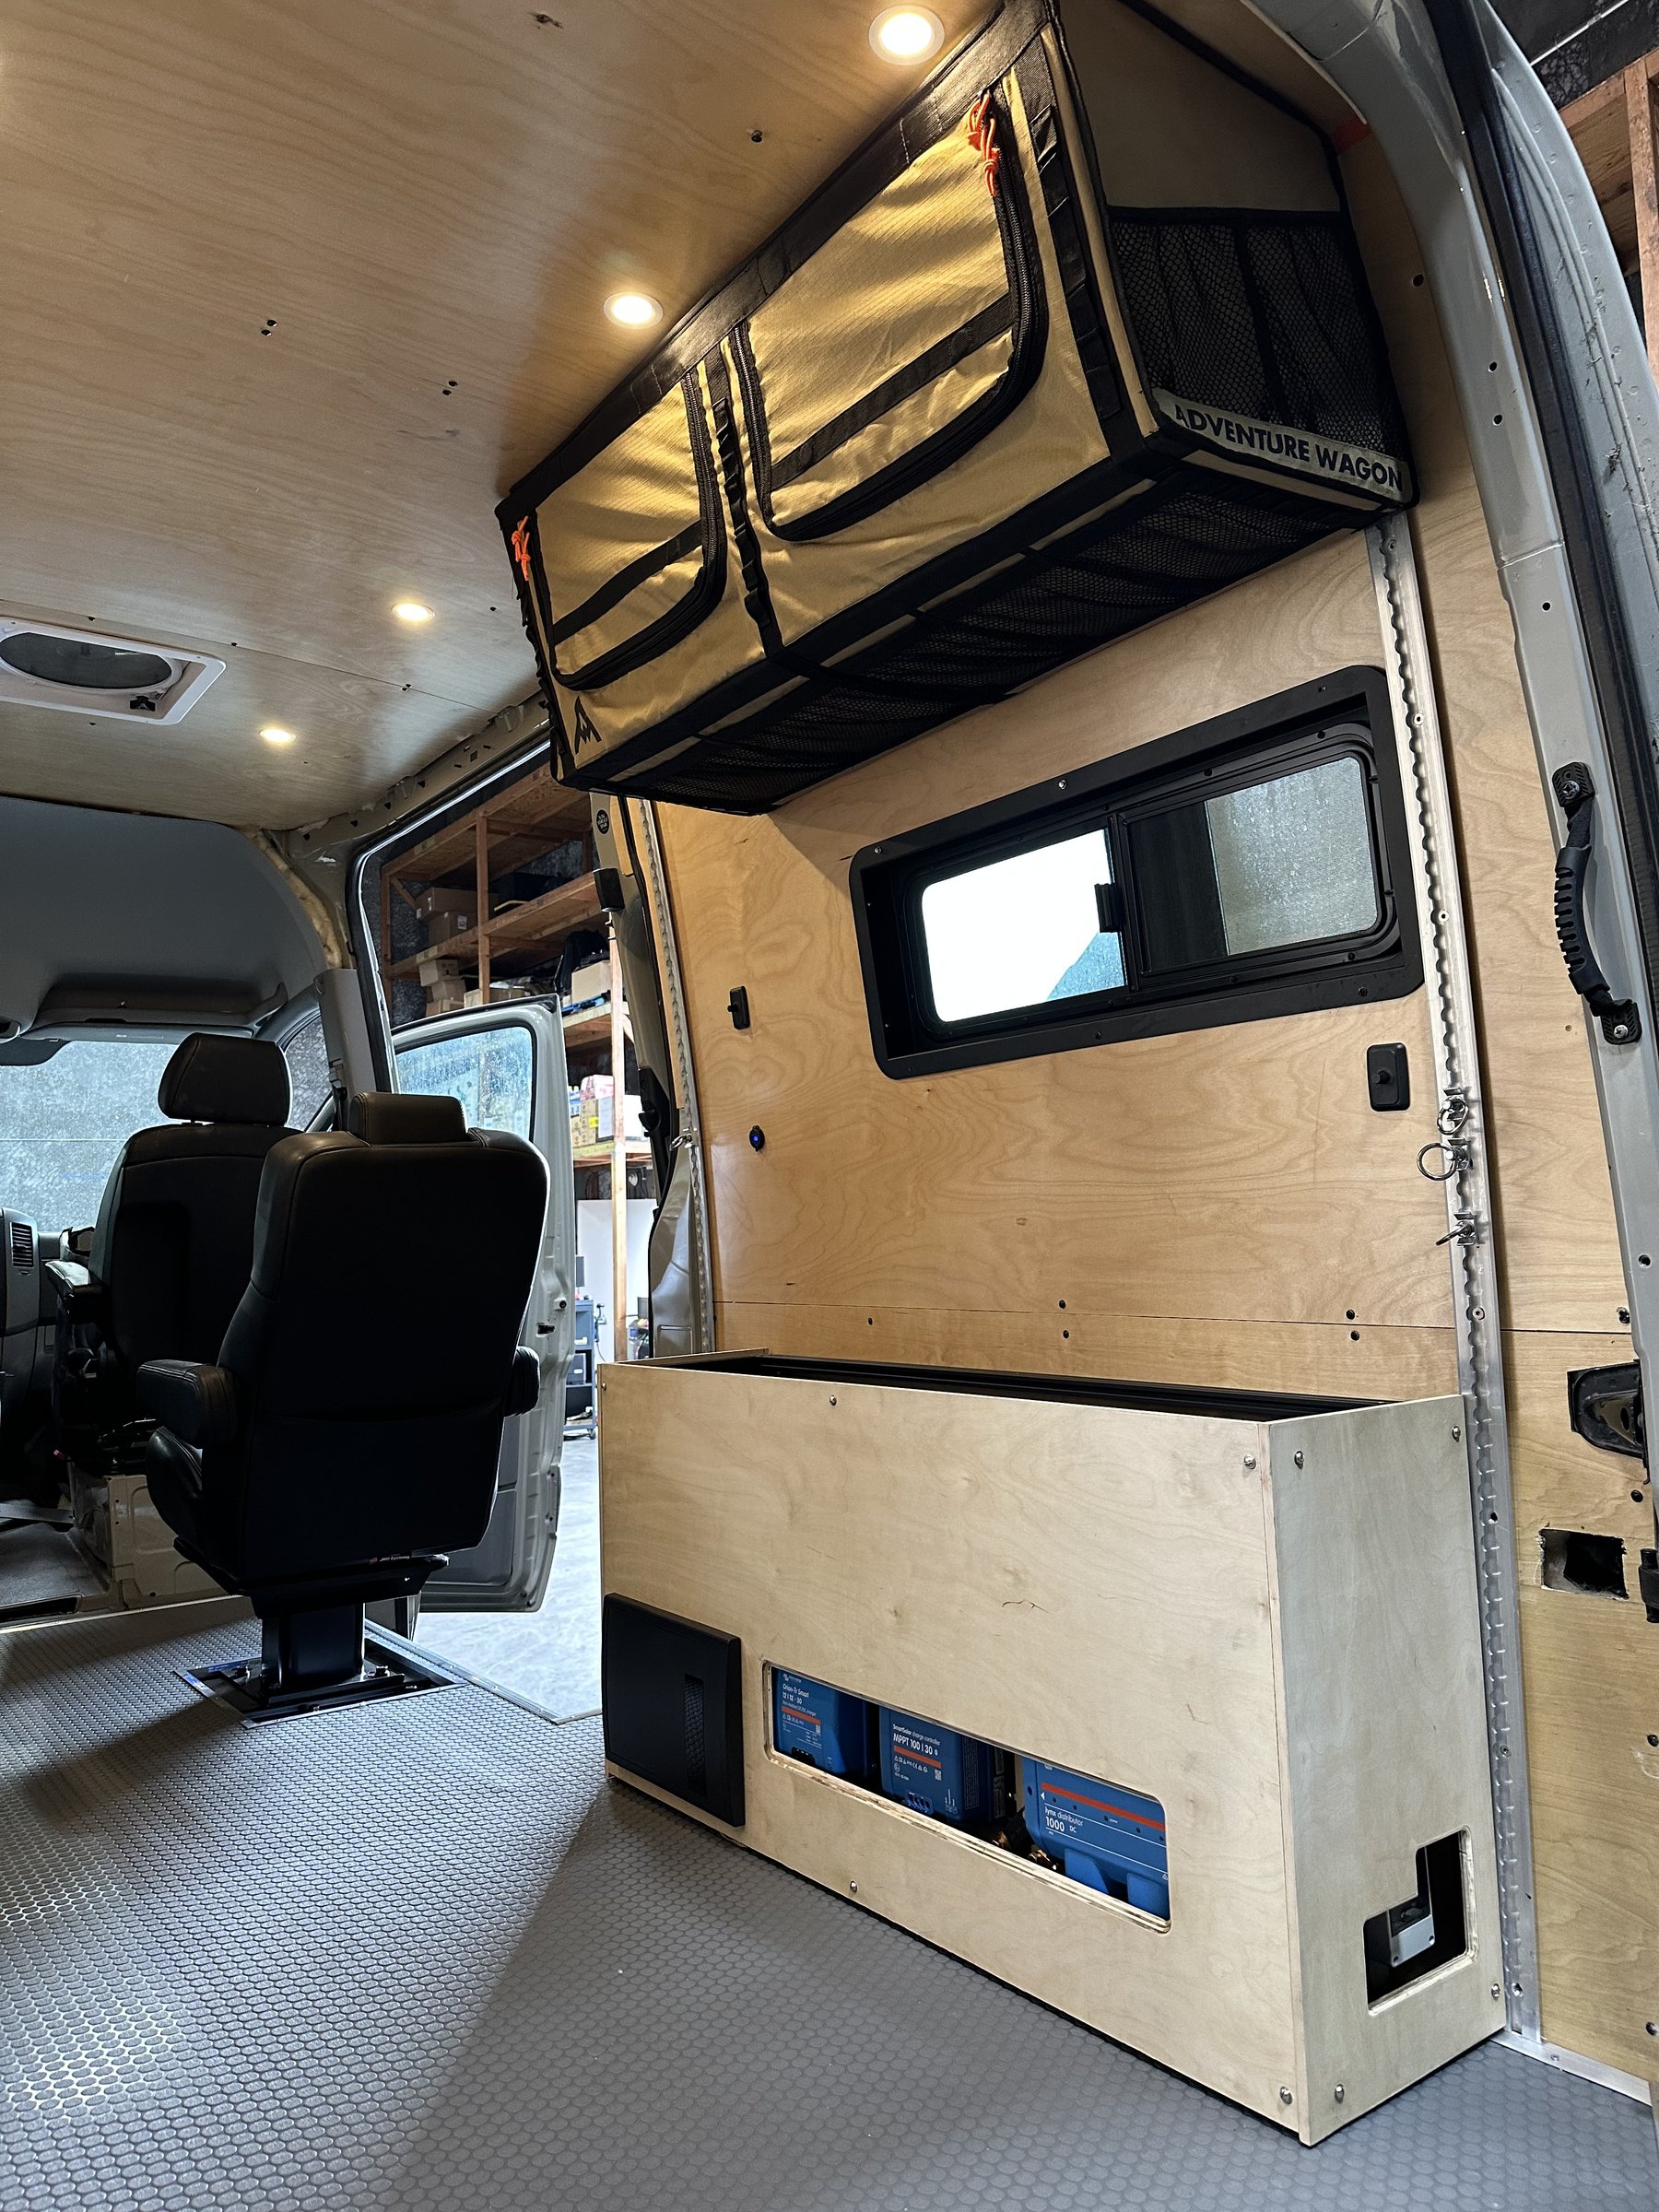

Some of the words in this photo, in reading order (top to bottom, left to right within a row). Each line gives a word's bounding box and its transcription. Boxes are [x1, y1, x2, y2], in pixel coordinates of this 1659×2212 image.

[1175, 404, 1310, 462] ADVENTURE
[1315, 444, 1403, 491] WAGON
[892, 1724, 912, 1735] SmartSolar
[912, 1730, 924, 1741] charge
[924, 1735, 941, 1746] controller
[893, 1733, 909, 1745] MPPT
[910, 1738, 921, 1750] 100
[924, 1744, 934, 1756] 30
[1044, 1806, 1057, 1818] lynx
[1057, 1812, 1084, 1827] distributor
[1045, 1817, 1065, 1832] 1000
